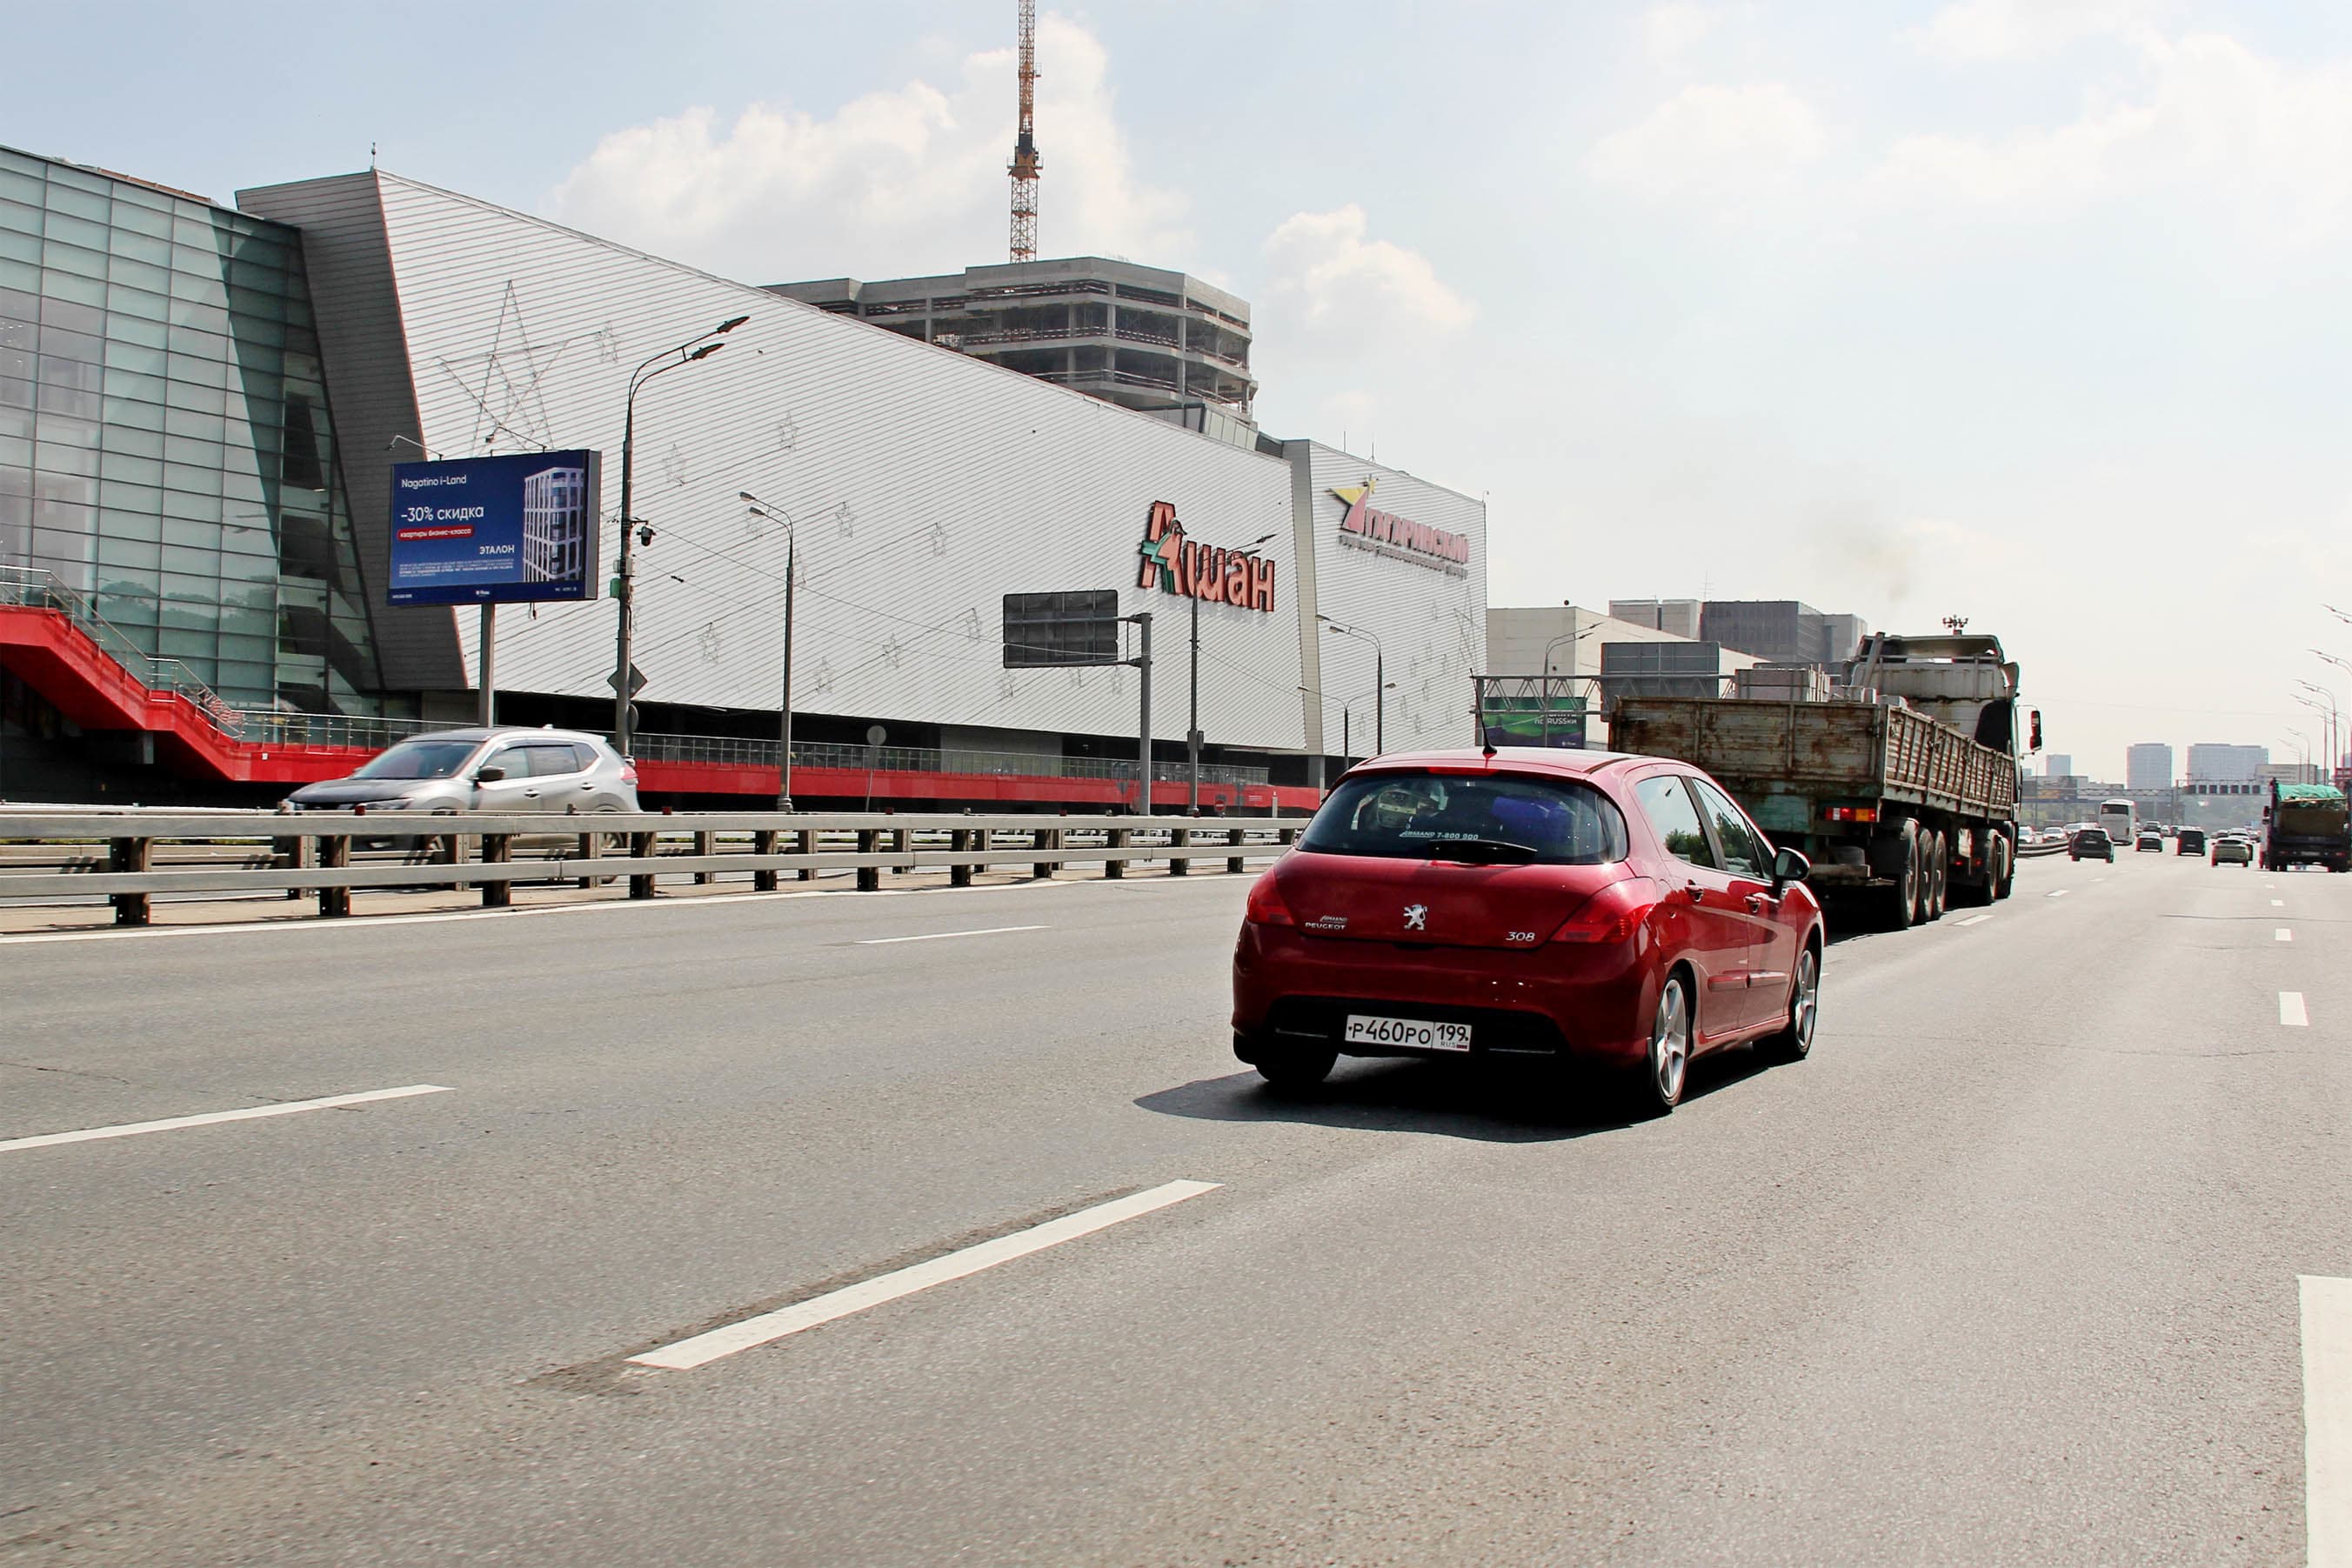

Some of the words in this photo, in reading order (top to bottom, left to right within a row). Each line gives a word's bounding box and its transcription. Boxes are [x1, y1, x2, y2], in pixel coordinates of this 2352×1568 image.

[401, 477, 439, 490] Nagatino
[440, 475, 467, 486] i-Land
[401, 506, 434, 522] -30%
[437, 506, 484, 521] скидка
[479, 544, 515, 555] ЭТАЛОН
[1139, 500, 1276, 612] Ашан
[1305, 922, 1346, 931] PEUGEOT
[1505, 931, 1535, 942] 308
[1437, 1024, 1467, 1042] 199
